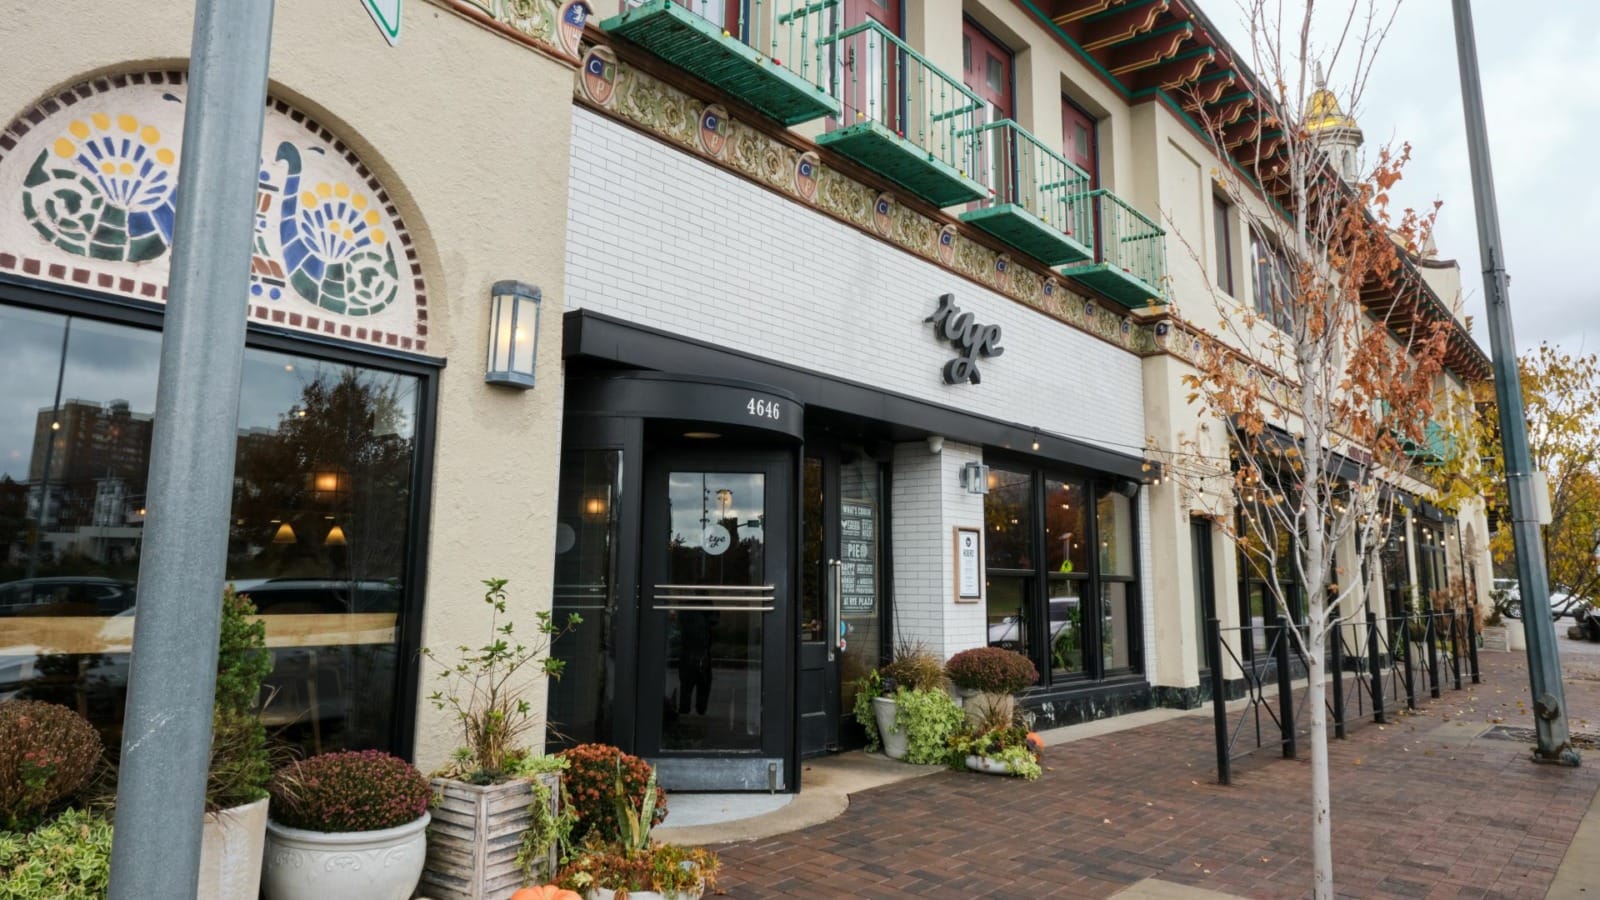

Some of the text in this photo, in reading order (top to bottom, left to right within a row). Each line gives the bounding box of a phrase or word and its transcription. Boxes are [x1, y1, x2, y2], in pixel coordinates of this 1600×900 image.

[922, 293, 1004, 384] rye
[747, 397, 780, 420] 4646
[709, 535, 726, 548] rye
